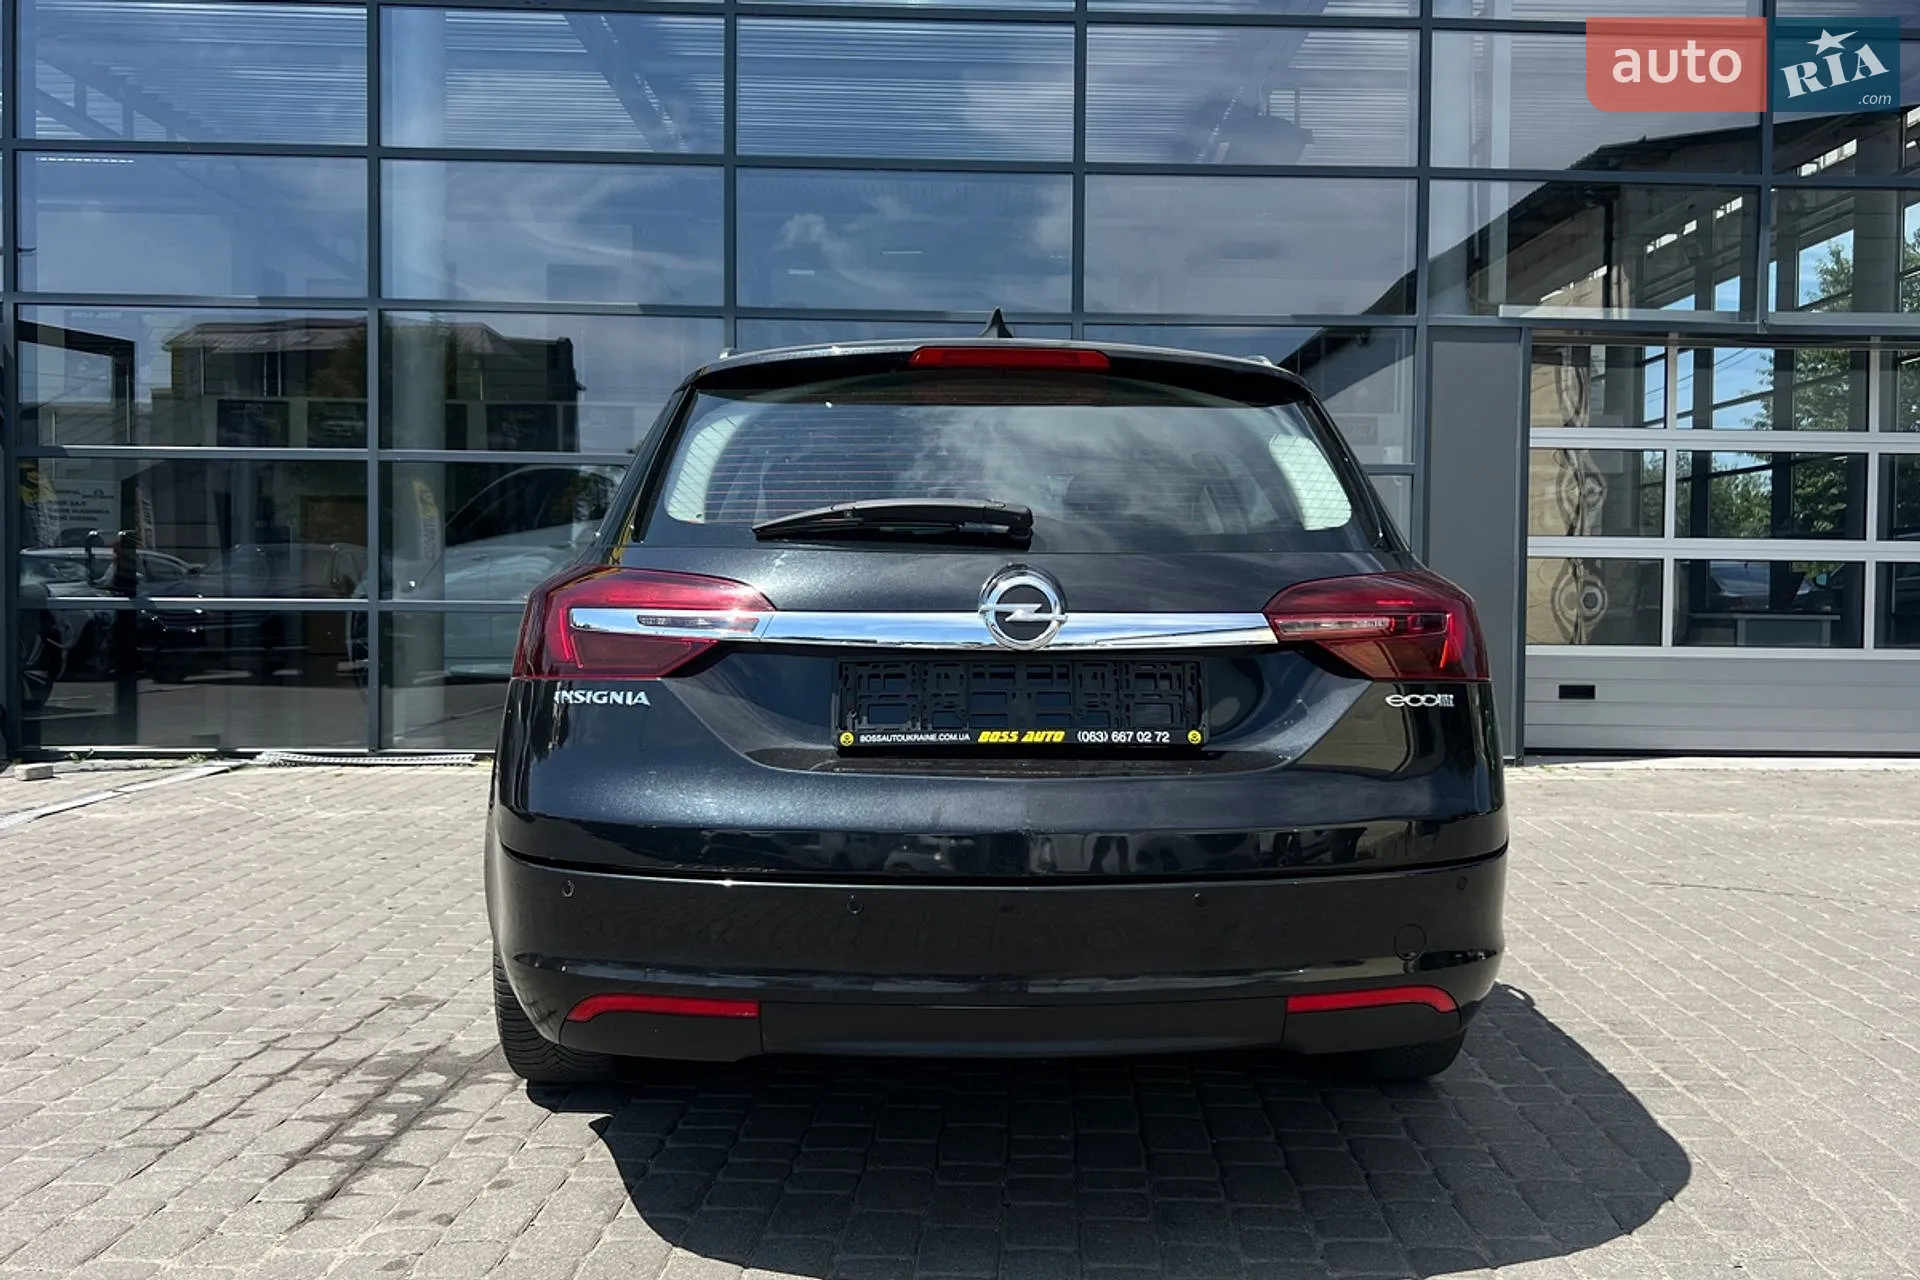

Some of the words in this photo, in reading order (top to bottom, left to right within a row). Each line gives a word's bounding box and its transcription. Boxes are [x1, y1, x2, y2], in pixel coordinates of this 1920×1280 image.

[553, 689, 651, 707] INSIGNIA
[859, 733, 971, 743] BOSSAUTOUKRAINE.COM.UA
[977, 730, 1019, 743] BOSS
[1020, 730, 1066, 743] AUTO
[1077, 731, 1109, 743] (063)
[1111, 731, 1134, 743] 667
[1136, 731, 1152, 743] 02
[1154, 731, 1170, 743] 72
